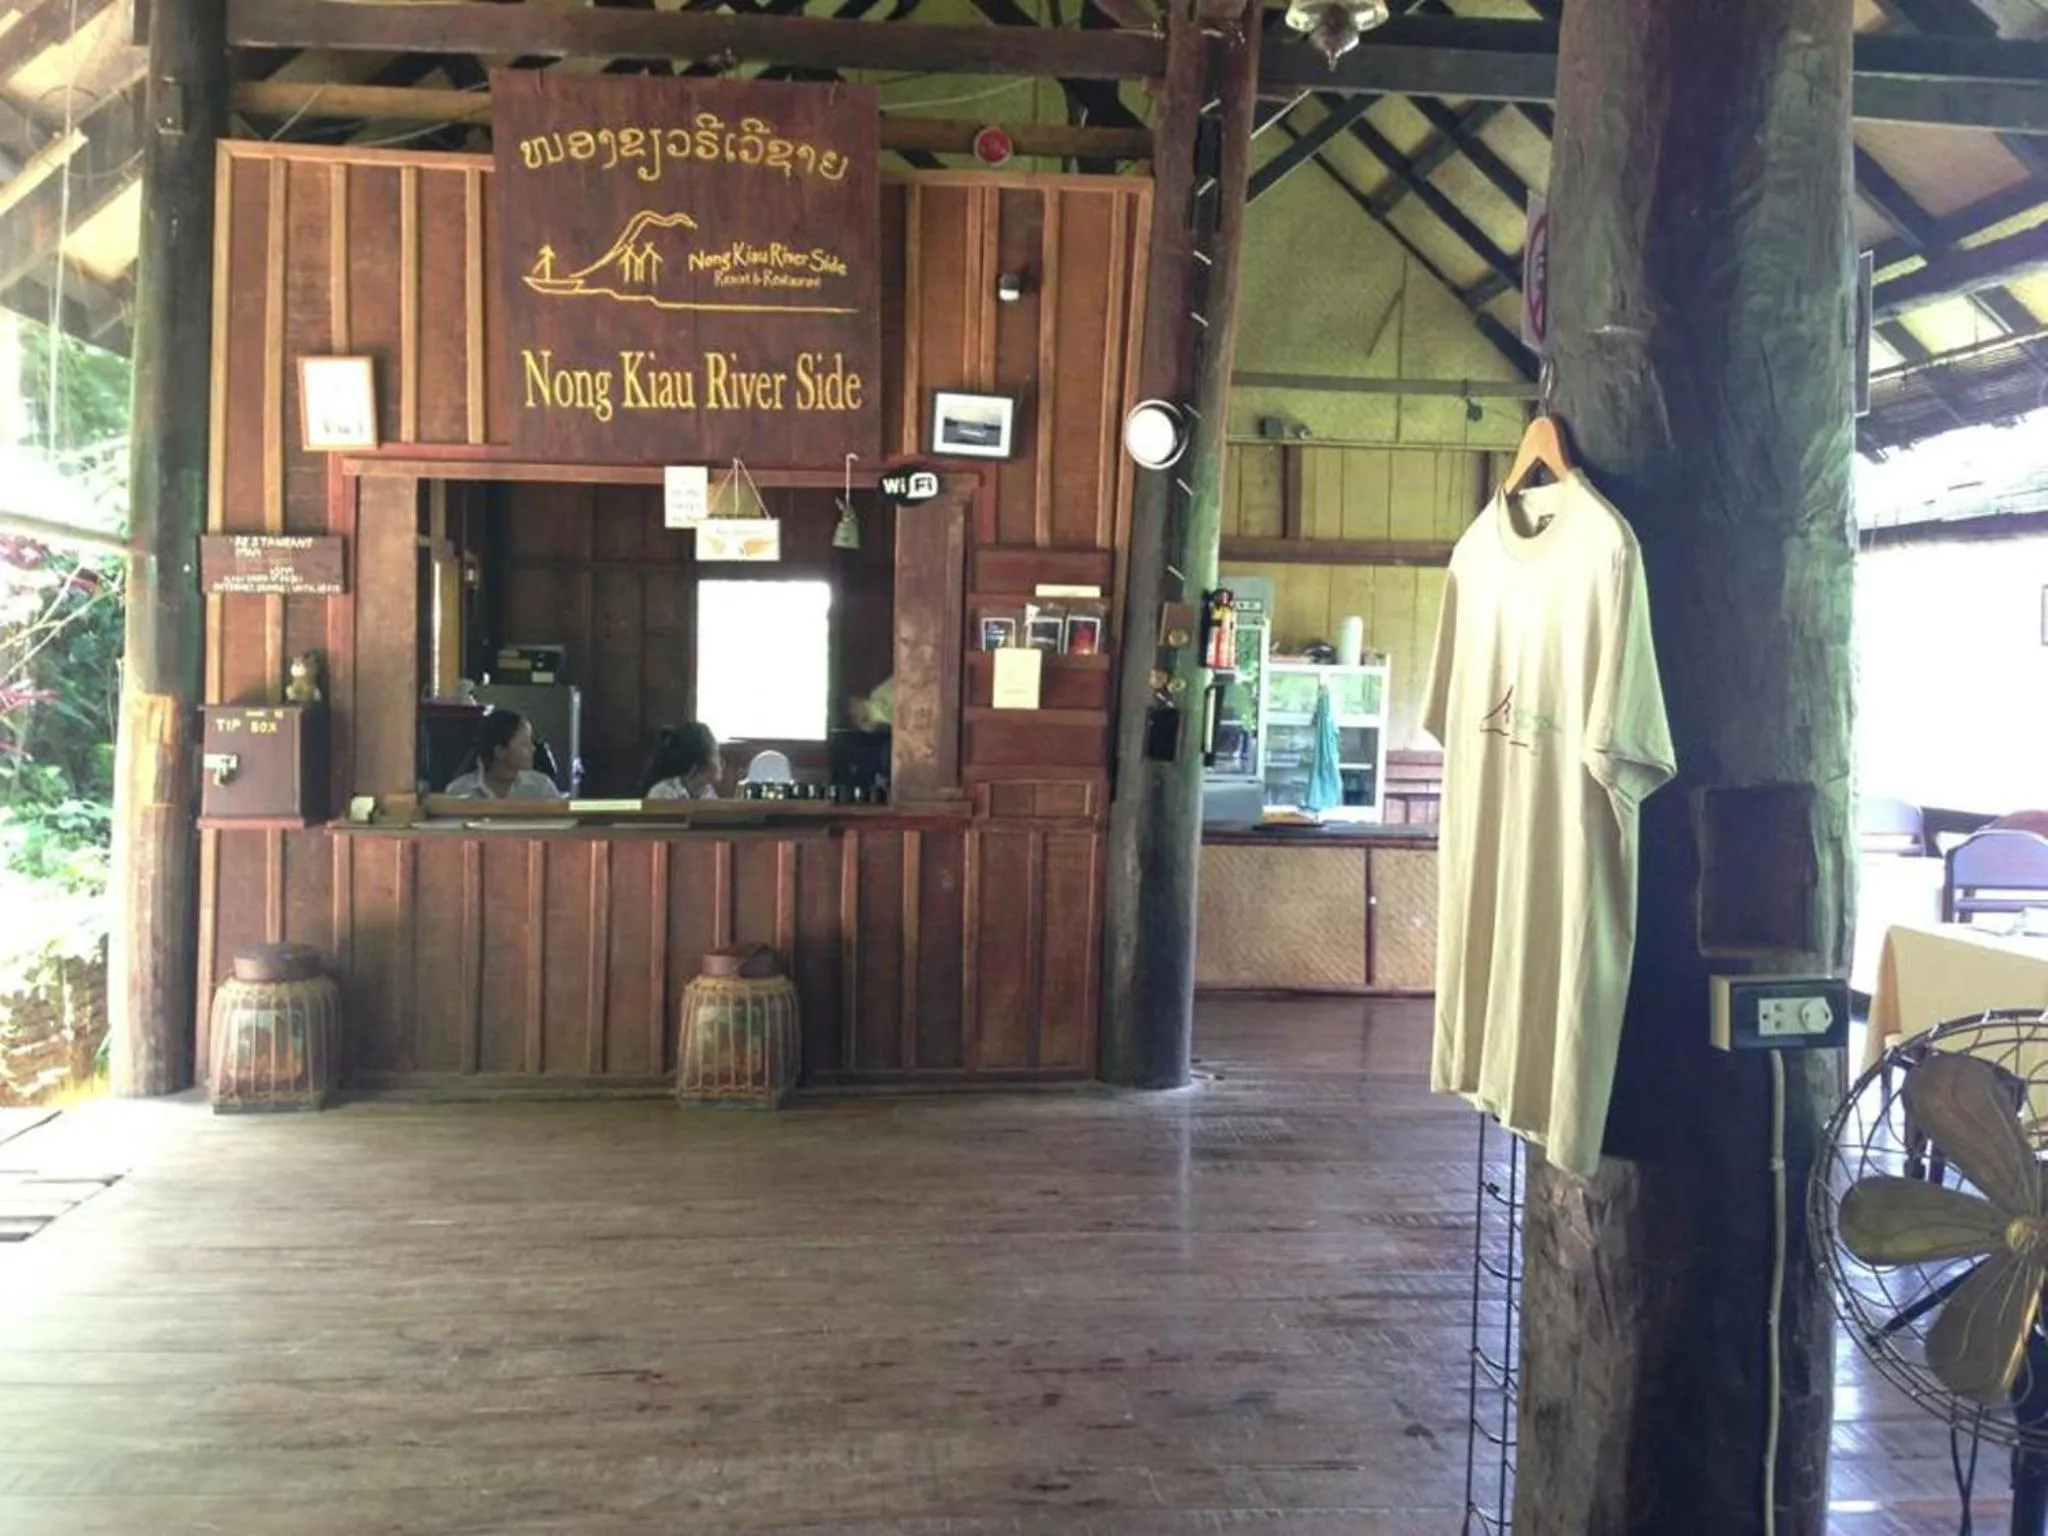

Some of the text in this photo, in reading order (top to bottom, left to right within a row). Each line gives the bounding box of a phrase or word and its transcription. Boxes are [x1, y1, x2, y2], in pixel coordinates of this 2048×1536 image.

[688, 241, 847, 277] Nong Kiau River Side
[521, 349, 862, 421] Nong Kiau River Side
[215, 718, 278, 733] TIP BOX
